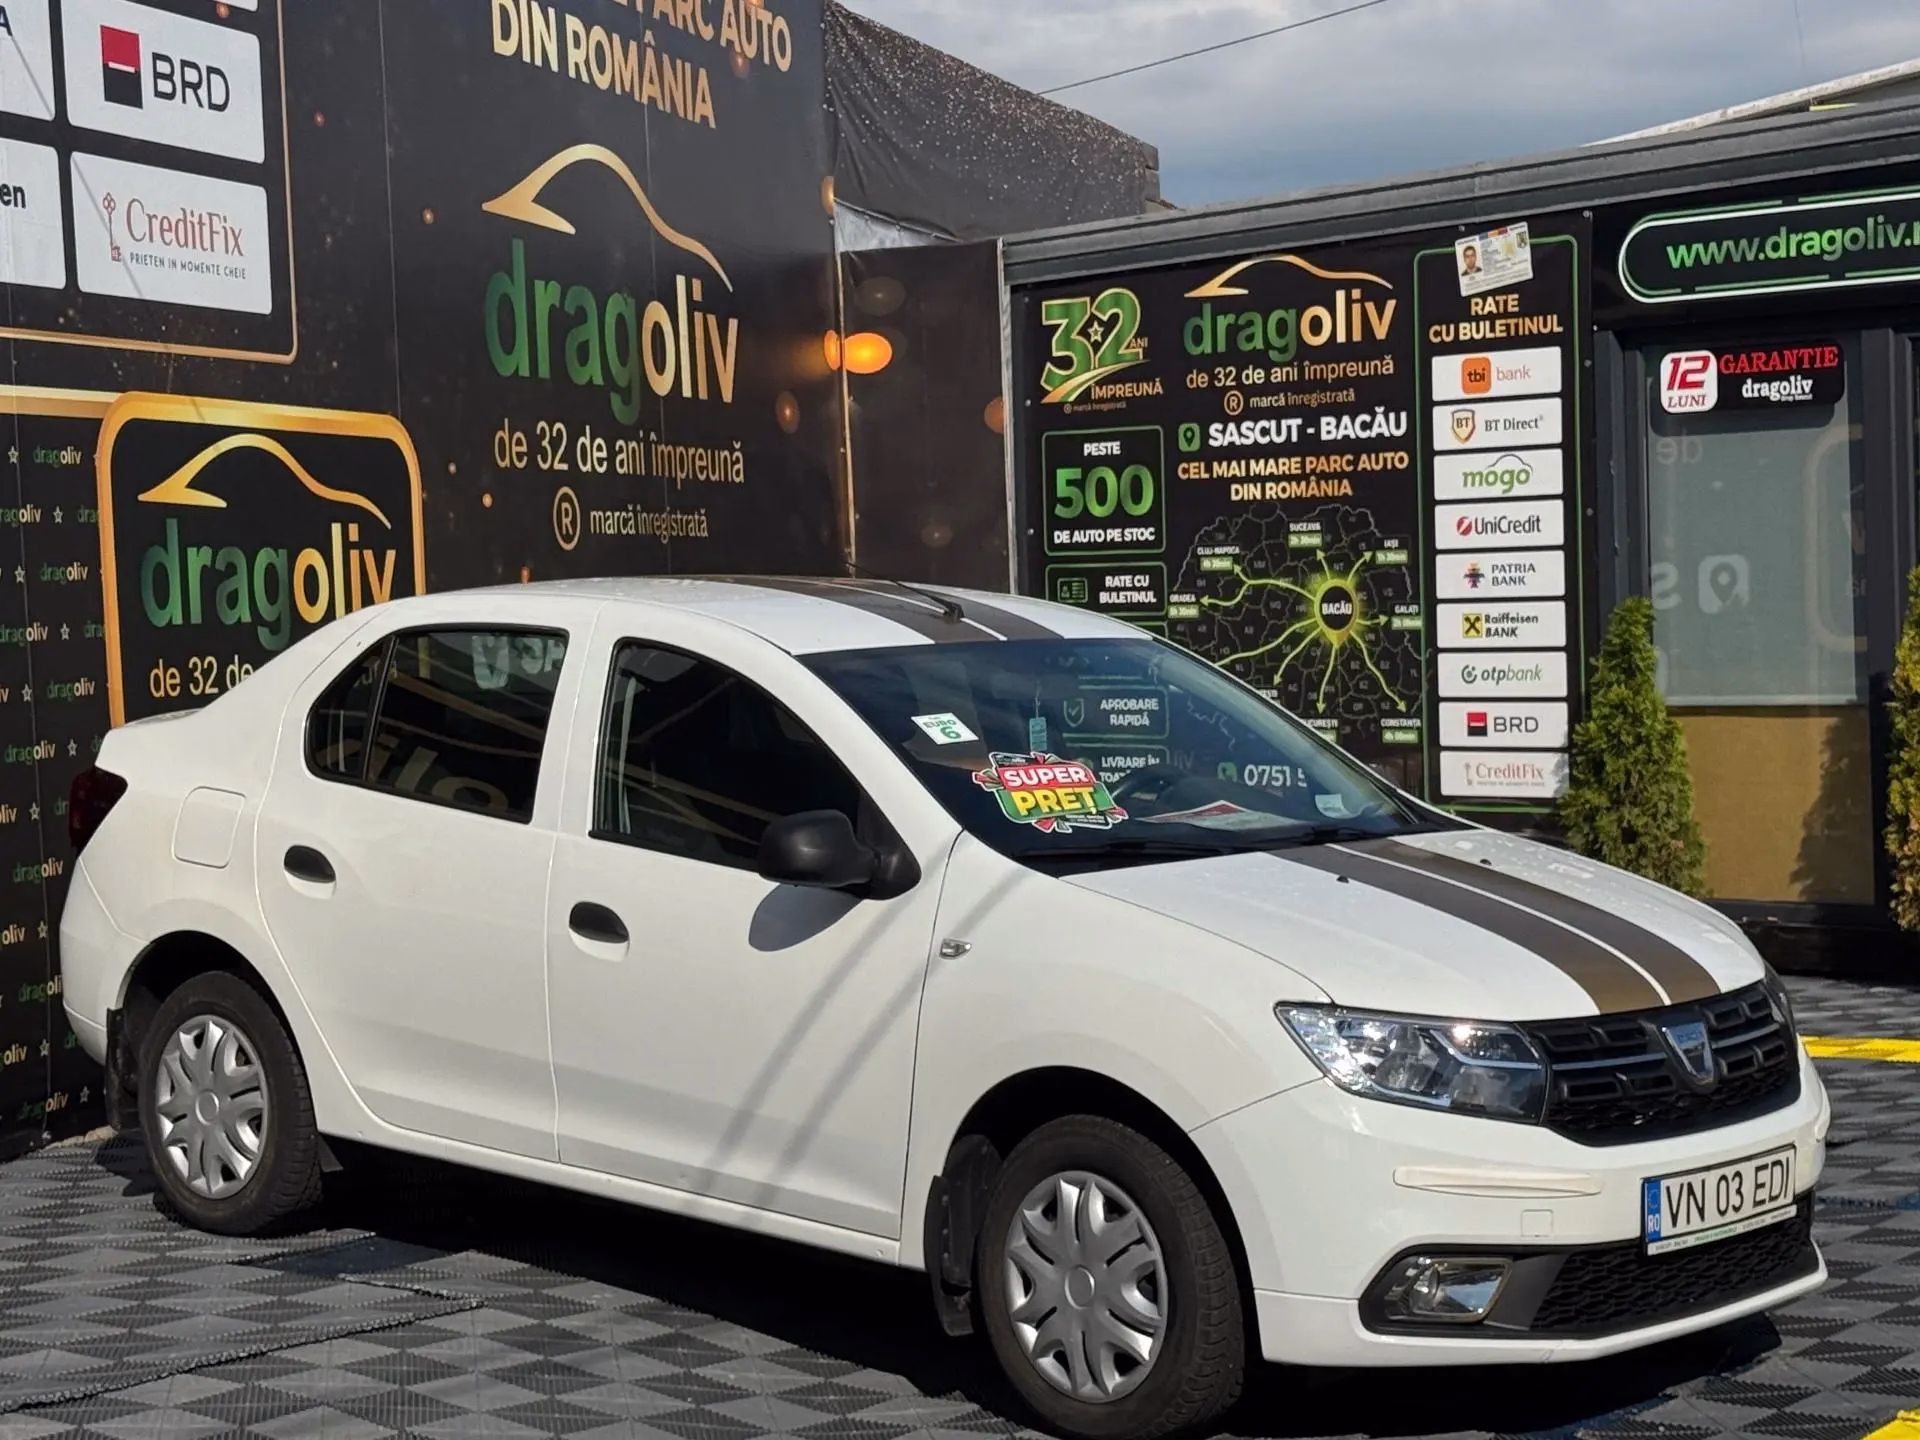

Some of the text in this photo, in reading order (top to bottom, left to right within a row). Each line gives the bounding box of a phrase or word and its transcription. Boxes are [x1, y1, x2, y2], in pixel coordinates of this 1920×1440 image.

[720, 0, 792, 72] AUTO
[491, 0, 716, 129] DIN ROMÂNIA
[151, 52, 230, 113] BRD
[126, 198, 244, 257] CreditFix
[130, 252, 246, 280] PRIETEN IN MOMENTE CHEIE
[1470, 294, 1519, 316] RATE
[485, 238, 738, 426] dragoliv
[1183, 288, 1397, 363] dragoliv
[1429, 314, 1563, 343] CU BULETINUL
[1040, 288, 1141, 392] 32
[1129, 337, 1148, 349] ANI
[1186, 355, 1394, 388] de 32 de ani împreună
[1719, 346, 1838, 375] GARANTIE
[1467, 365, 1532, 383] tbi bank
[1666, 355, 1711, 391] 12
[1091, 377, 1164, 400] ÎMPREUNĂ
[1742, 374, 1813, 402] dragoliv
[1250, 395, 1286, 408] marcă
[1667, 395, 1706, 409] LUNI
[1208, 419, 1302, 447] SASCUT
[1320, 407, 1408, 441] BACĂU
[1456, 417, 1470, 429] BT
[1484, 420, 1500, 432] BT
[33, 446, 81, 468] dragoliv
[494, 418, 745, 489] de 32 de ani împreună
[1083, 441, 1121, 456] PESTE
[1177, 451, 1409, 480] CEL MAI MARE PARC AUTO
[1054, 464, 1154, 519] 500
[1230, 480, 1352, 501] DIN ROMÂNIA
[1462, 468, 1531, 494] mogo
[590, 507, 635, 535] marcă
[637, 505, 708, 544] înregistrată
[1054, 527, 1155, 544] DE AUTO PE STOC
[1474, 514, 1542, 535] UniCredit
[40, 561, 88, 586] dragoliv
[1491, 562, 1536, 575] PATRIA
[141, 518, 396, 650] dragoliv
[1105, 575, 1149, 588] RATE CU
[1491, 575, 1527, 587] BANK
[1099, 591, 1156, 604] BULETINUL
[1321, 600, 1352, 616] BACĂU
[1484, 611, 1539, 625] Raiffeisen
[1485, 626, 1519, 639] BANK
[150, 660, 181, 697] de
[188, 656, 219, 695] 32
[1481, 664, 1542, 686] otpbank
[48, 677, 95, 702] dragoliv
[1100, 698, 1159, 711] APROBARE
[939, 726, 962, 740] 6
[1493, 716, 1539, 733] BRD
[5, 740, 56, 765] dragoliv
[1003, 766, 1089, 788] SUPER
[1244, 764, 1291, 788] 0751
[1476, 762, 1544, 780] CreditFix
[13, 857, 63, 884] dragoliv
[1666, 1156, 1790, 1228] VN 03 EDI
[1648, 1213, 1660, 1233] RO
